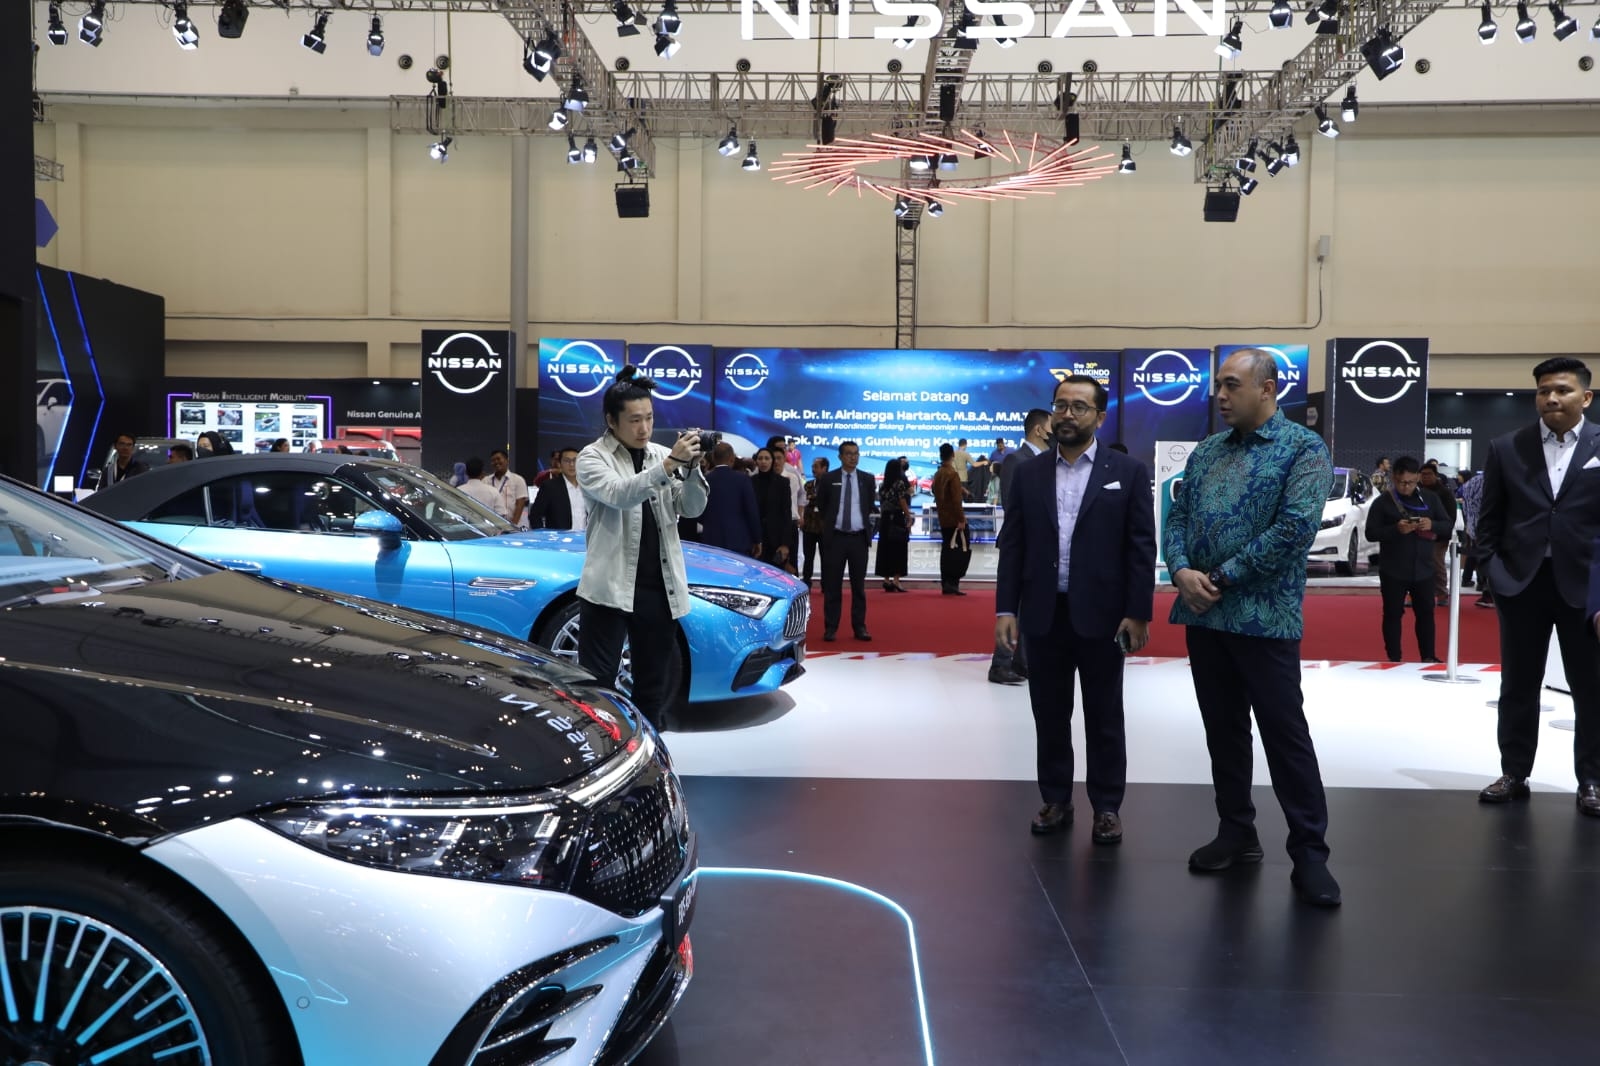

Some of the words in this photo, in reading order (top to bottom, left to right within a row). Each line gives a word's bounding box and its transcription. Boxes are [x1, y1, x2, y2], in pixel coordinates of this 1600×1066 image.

[740, 0, 1227, 40] NISSAN
[428, 357, 502, 369] NISSAN
[547, 363, 616, 375] NISSAN
[636, 367, 703, 379] NISSAN
[724, 368, 770, 376] NISSAN
[1132, 372, 1202, 383] NISSAN
[1342, 366, 1421, 379] NISSAN
[192, 391, 220, 401] NISSAN
[221, 391, 268, 401] INTELLIGENT
[269, 392, 308, 402] MOBILITY
[862, 390, 918, 402] Selamat
[920, 391, 969, 405] Datang
[346, 410, 376, 419] Nissan
[377, 411, 414, 419] Genuine
[773, 409, 801, 422] Bpk.
[803, 409, 820, 420] Dr.
[821, 410, 833, 420] Ir.
[834, 410, 894, 423] Airlangga
[896, 411, 953, 423] Hartarto,
[813, 435, 830, 446] Dr.
[864, 436, 931, 449] Gumiwang
